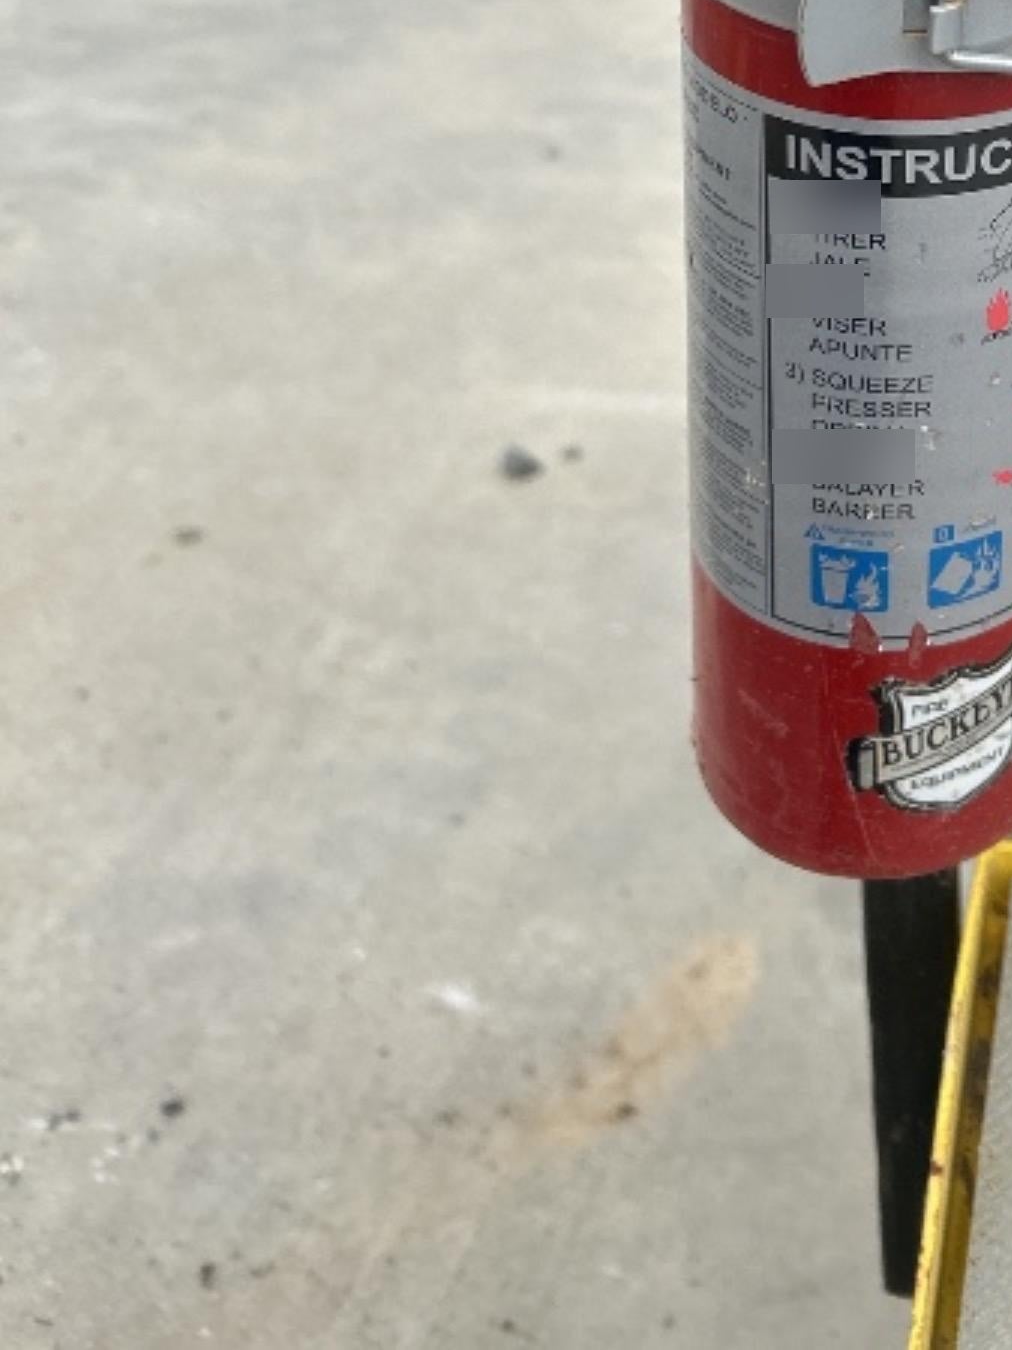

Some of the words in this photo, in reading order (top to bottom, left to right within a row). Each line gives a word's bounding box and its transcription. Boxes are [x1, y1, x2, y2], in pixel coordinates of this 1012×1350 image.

[812, 318, 887, 337] VISER
[809, 337, 913, 363] APUNTE
[812, 367, 934, 393] SQUEEZE
[812, 392, 931, 418] PRESSER
